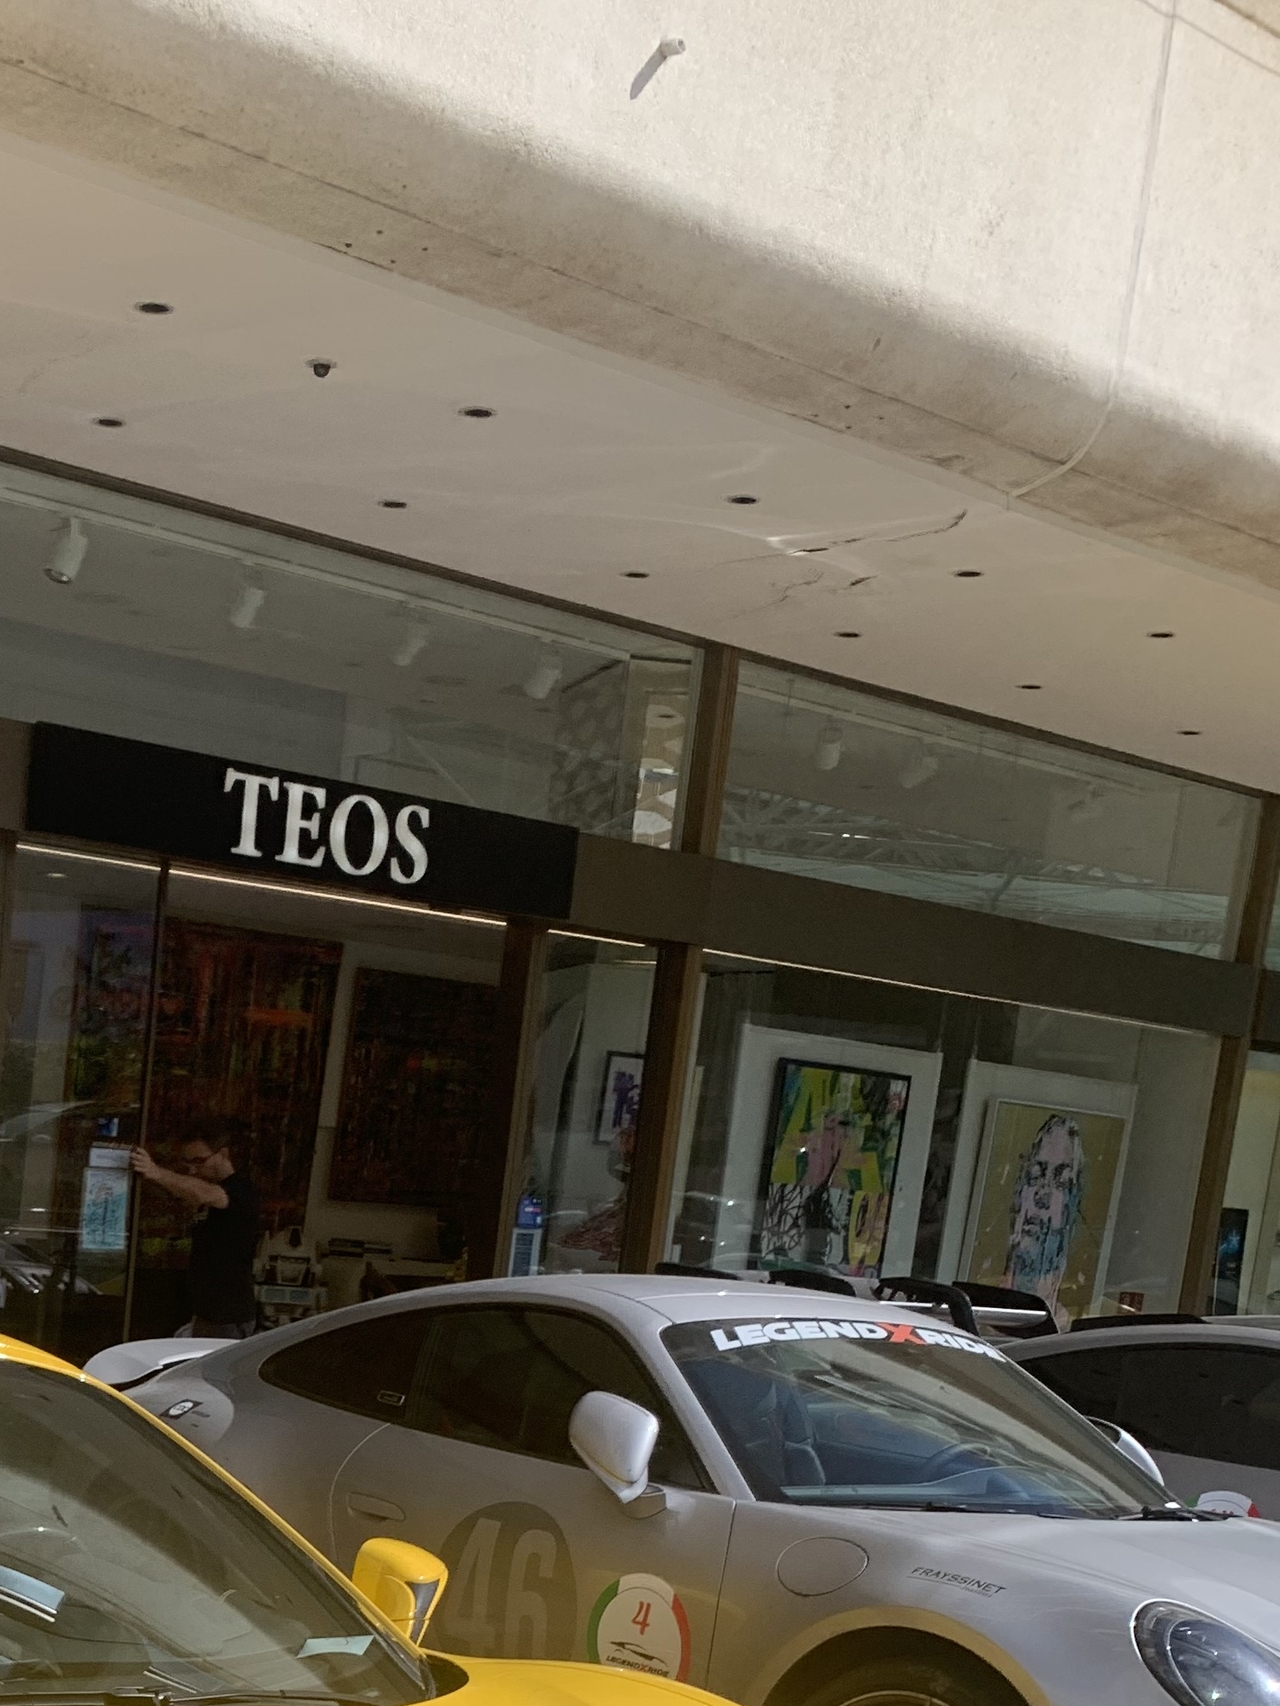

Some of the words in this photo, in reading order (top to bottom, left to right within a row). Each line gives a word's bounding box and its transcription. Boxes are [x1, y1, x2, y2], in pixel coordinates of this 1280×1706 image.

[224, 768, 431, 885] TEOS
[444, 1517, 558, 1659] 46
[911, 1566, 1008, 1594] FRAYSSINET
[631, 1600, 653, 1636] 4
[605, 1654, 671, 1678] LEGENDXRIDE
